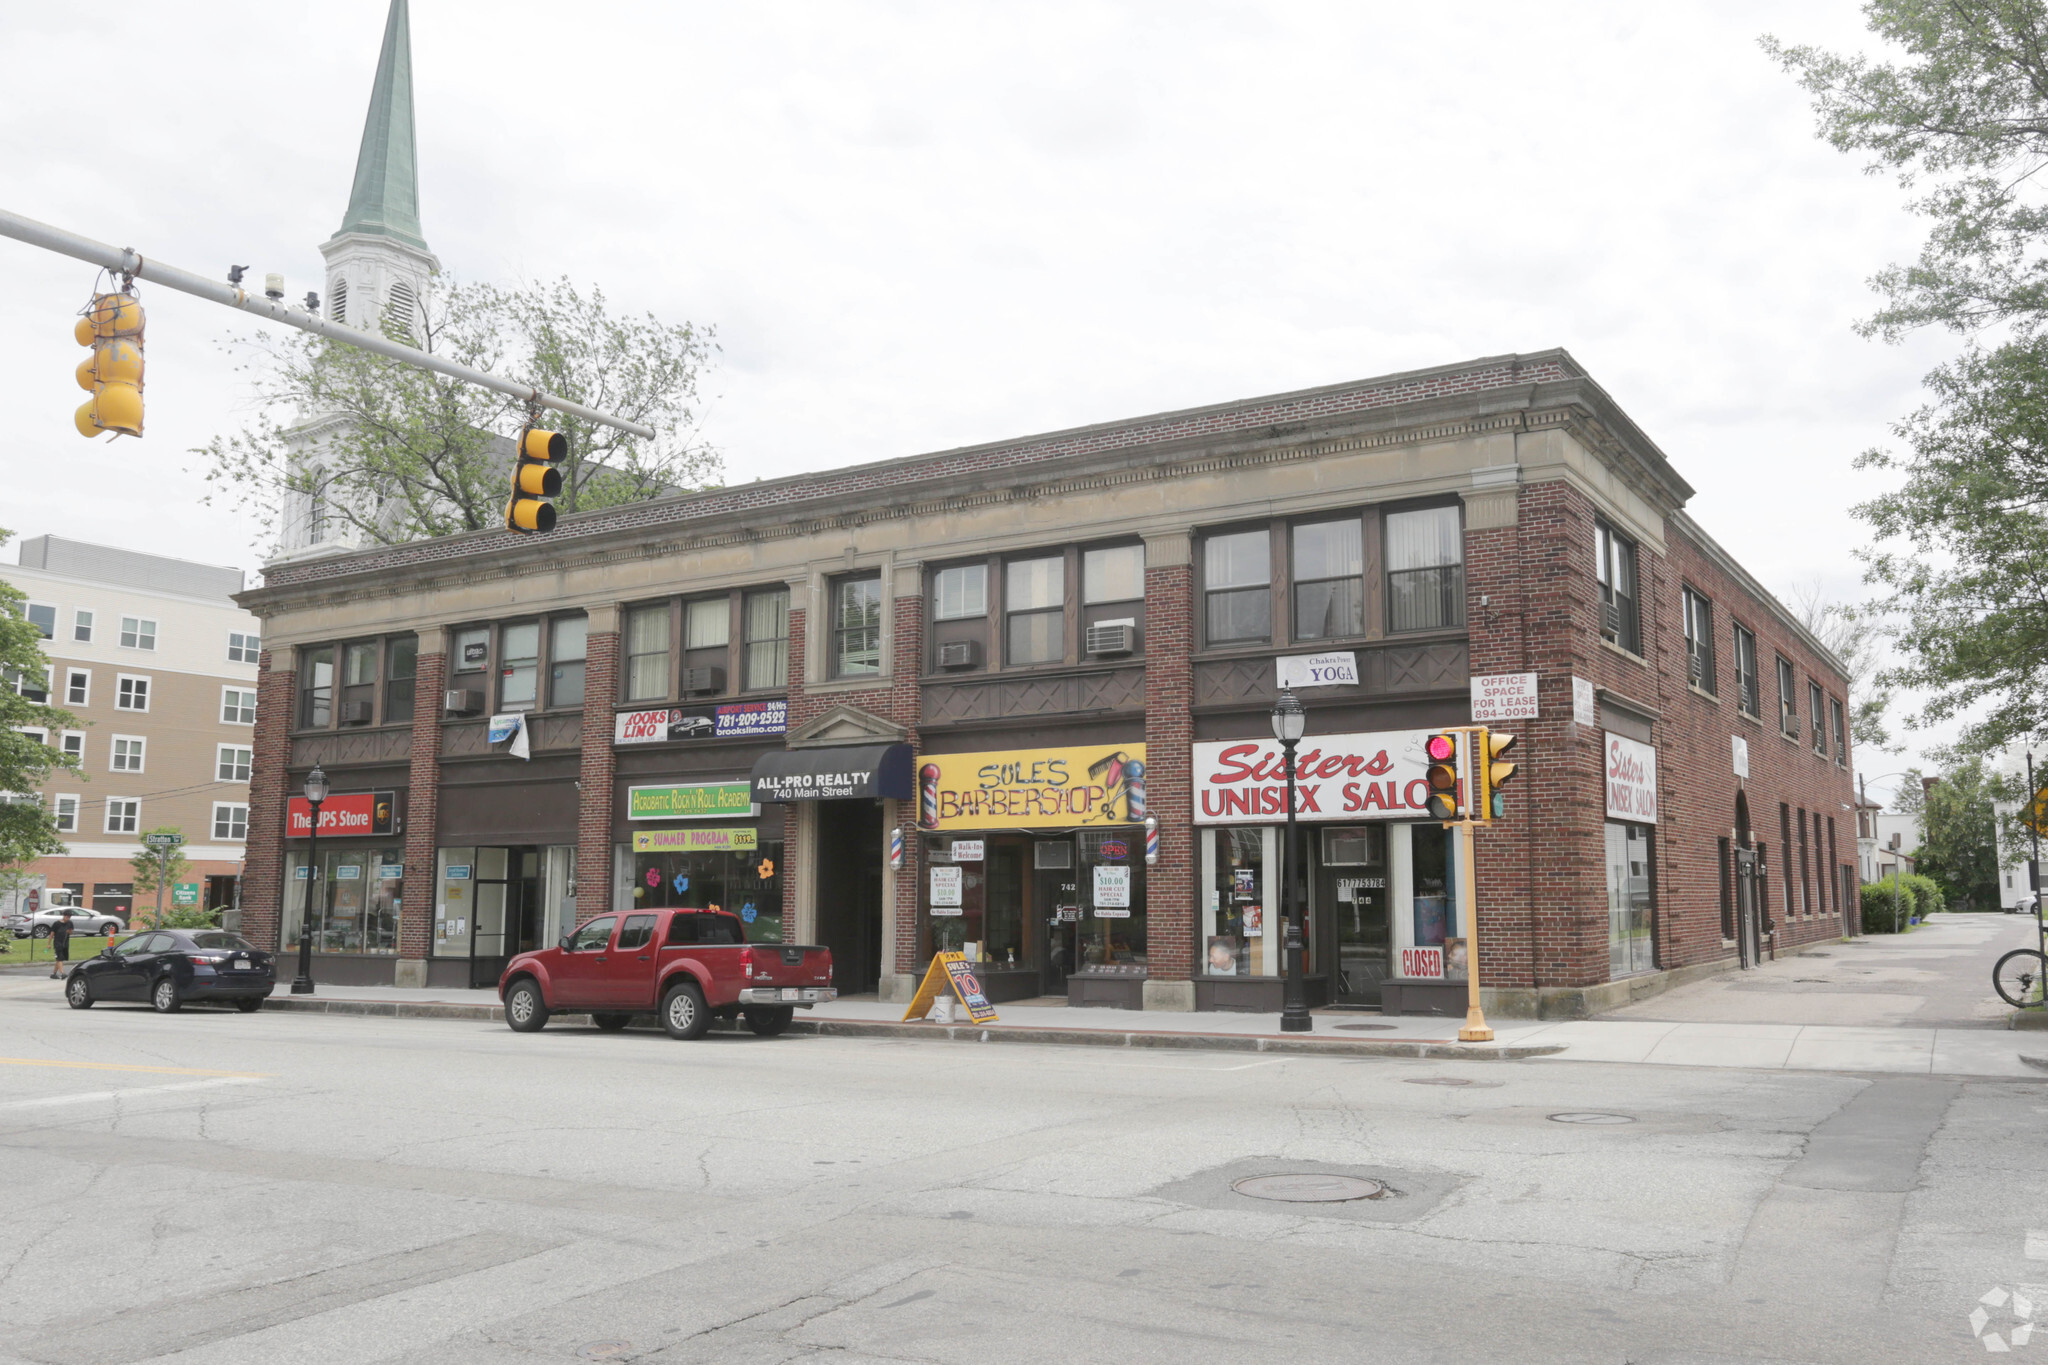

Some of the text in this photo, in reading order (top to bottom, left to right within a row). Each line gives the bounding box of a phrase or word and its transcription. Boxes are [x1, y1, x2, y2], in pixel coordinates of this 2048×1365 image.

[1309, 657, 1336, 665] Chakra
[1310, 666, 1354, 681] YOGA
[1481, 675, 1527, 686] OFFICE
[1484, 686, 1525, 697] SPACE
[718, 704, 742, 714] AIRPORT
[743, 703, 767, 713] SERVICE
[1473, 696, 1536, 708] FOR LEASE
[1475, 707, 1536, 719] 894-0094
[623, 724, 657, 738] LIMO
[716, 725, 786, 737] brookslimo.com
[1209, 744, 1394, 784] Sisters
[1609, 740, 1644, 785] Sisters
[978, 758, 1070, 789] SULE'S
[757, 772, 871, 789] ALL-PRO REALTY
[773, 786, 853, 799] 740 Main Street
[938, 785, 1106, 819] BARBERSHOP
[1607, 781, 1656, 818] UNISEX SALON
[293, 812, 312, 828] The
[339, 810, 369, 826] Store
[150, 835, 171, 843] Stratton
[654, 832, 685, 846] SUMMER
[691, 831, 729, 845] PROGRAM
[1100, 845, 1128, 855] OPEN
[1100, 877, 1123, 886] $10.00
[1402, 949, 1441, 976] CLOSED
